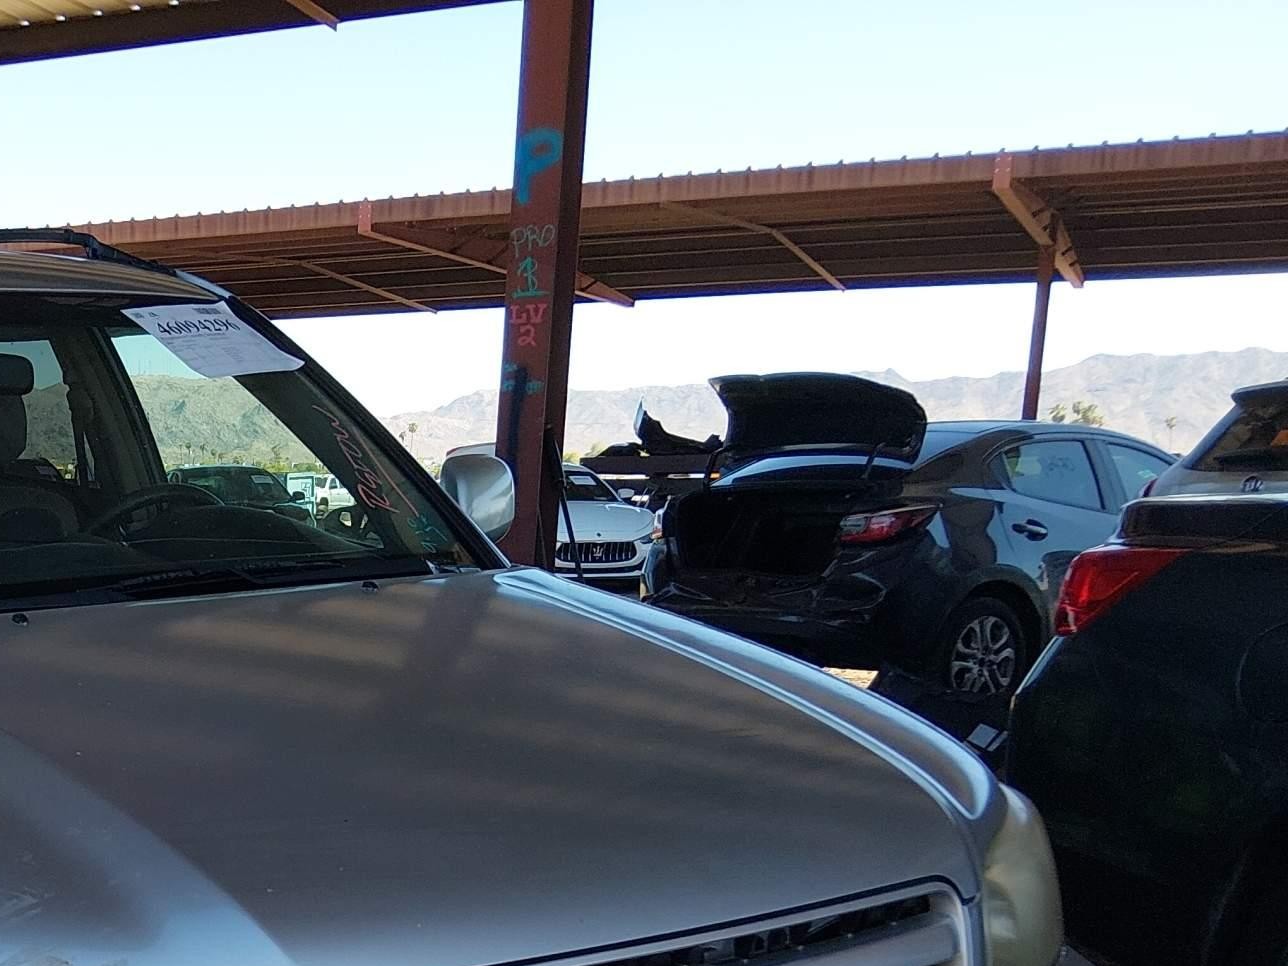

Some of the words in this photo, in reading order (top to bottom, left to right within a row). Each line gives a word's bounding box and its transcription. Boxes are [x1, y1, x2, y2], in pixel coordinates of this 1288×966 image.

[516, 127, 564, 206] P
[511, 223, 556, 258] PRO
[510, 303, 548, 324] LV
[156, 317, 242, 337] 46094296
[518, 324, 537, 346] 2
